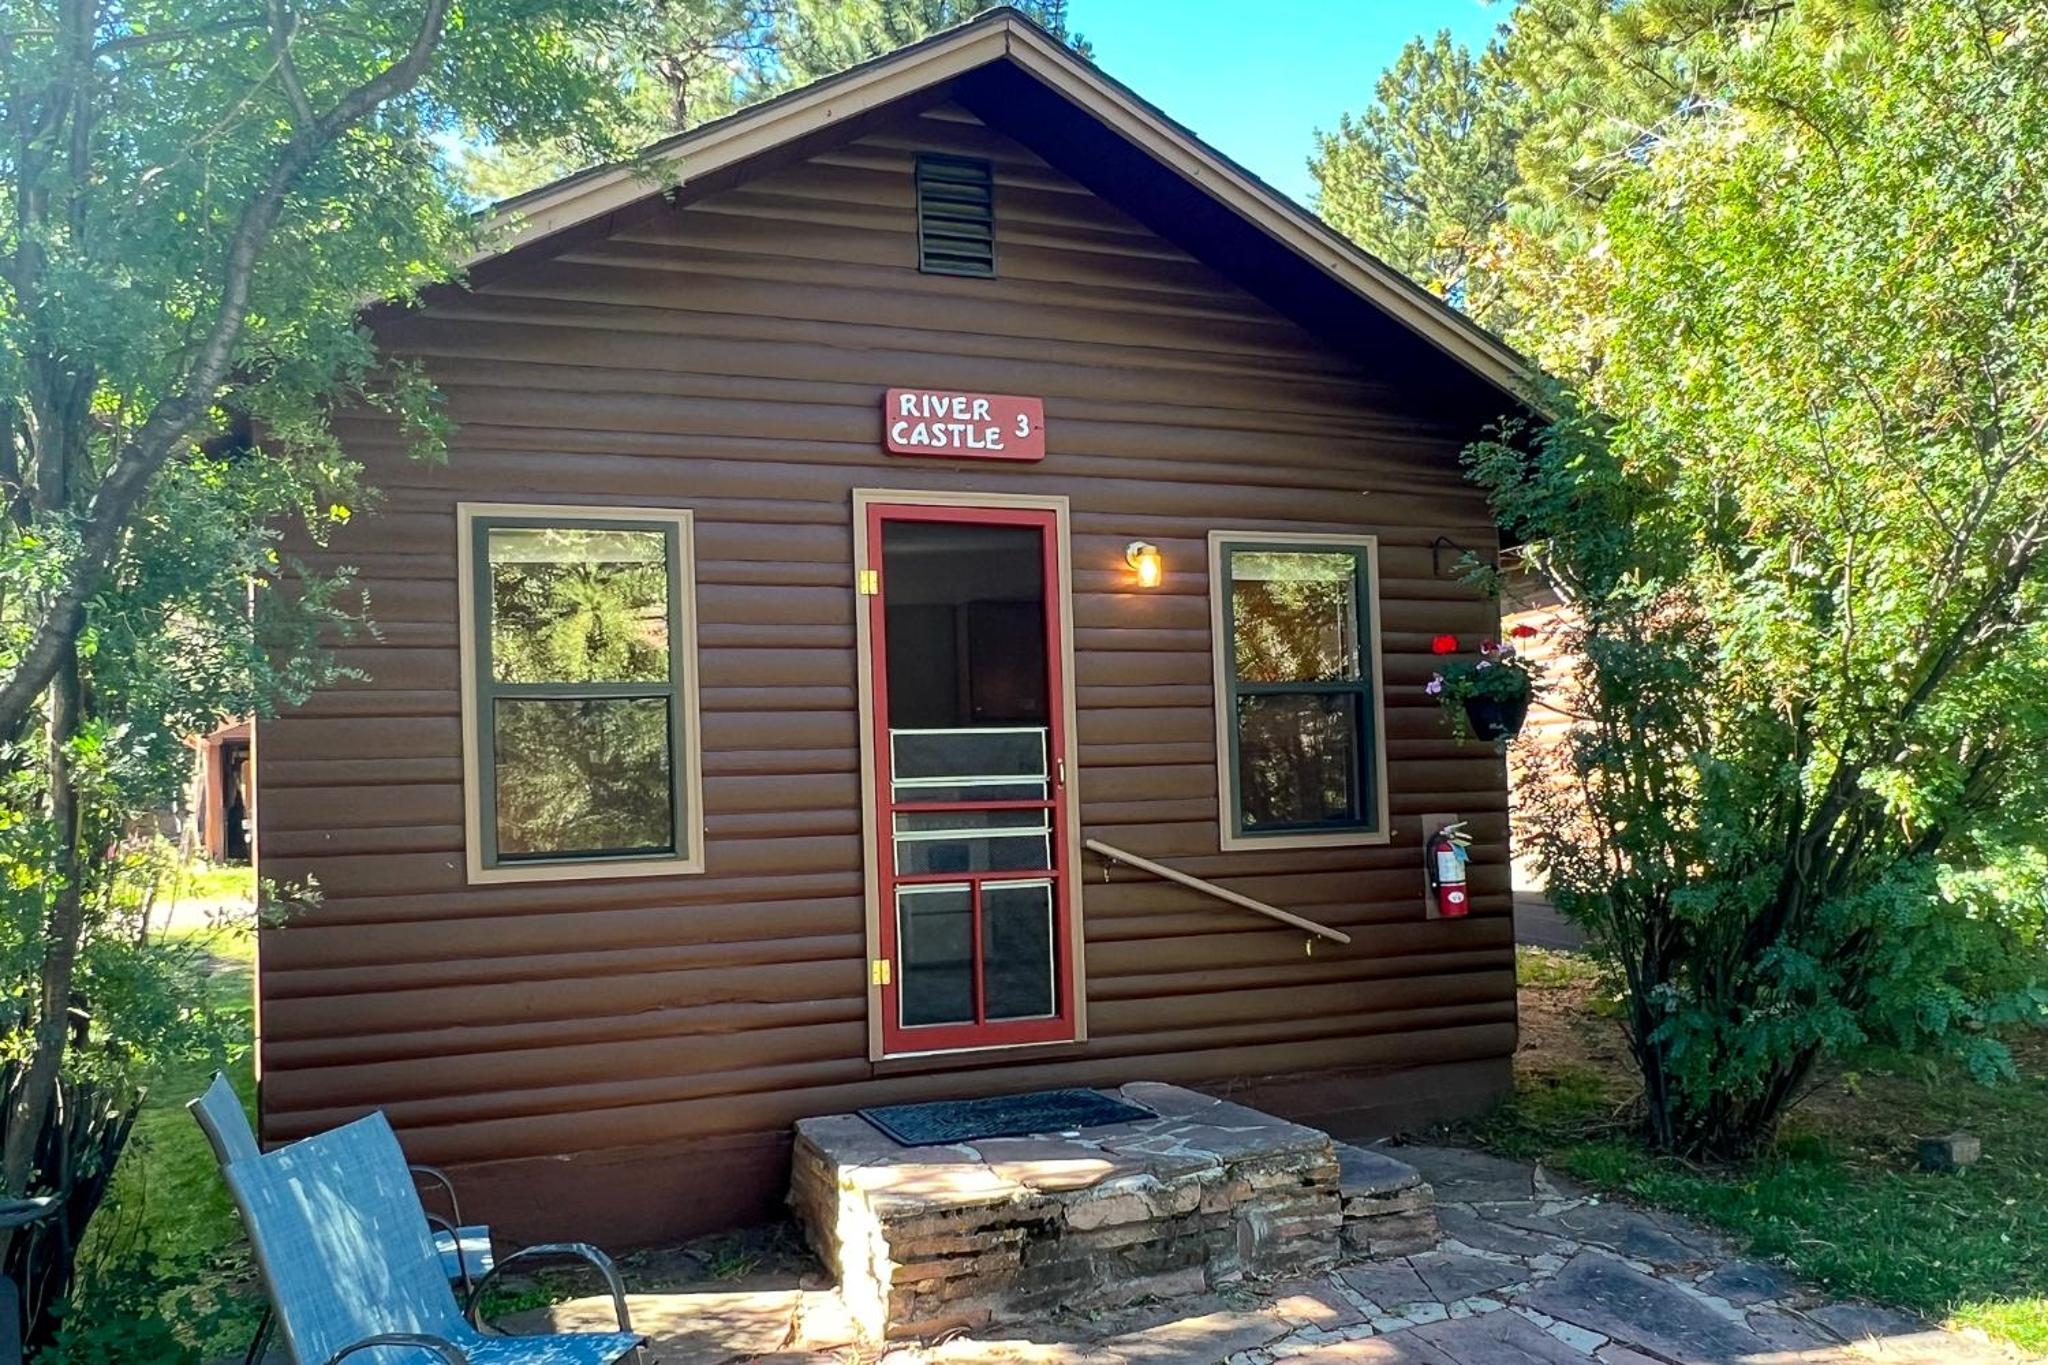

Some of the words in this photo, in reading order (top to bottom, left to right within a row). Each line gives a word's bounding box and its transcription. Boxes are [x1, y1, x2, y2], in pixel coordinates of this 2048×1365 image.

[900, 394, 991, 421] RIVER
[892, 421, 1004, 450] CASTLE
[1015, 414, 1029, 437] 3
